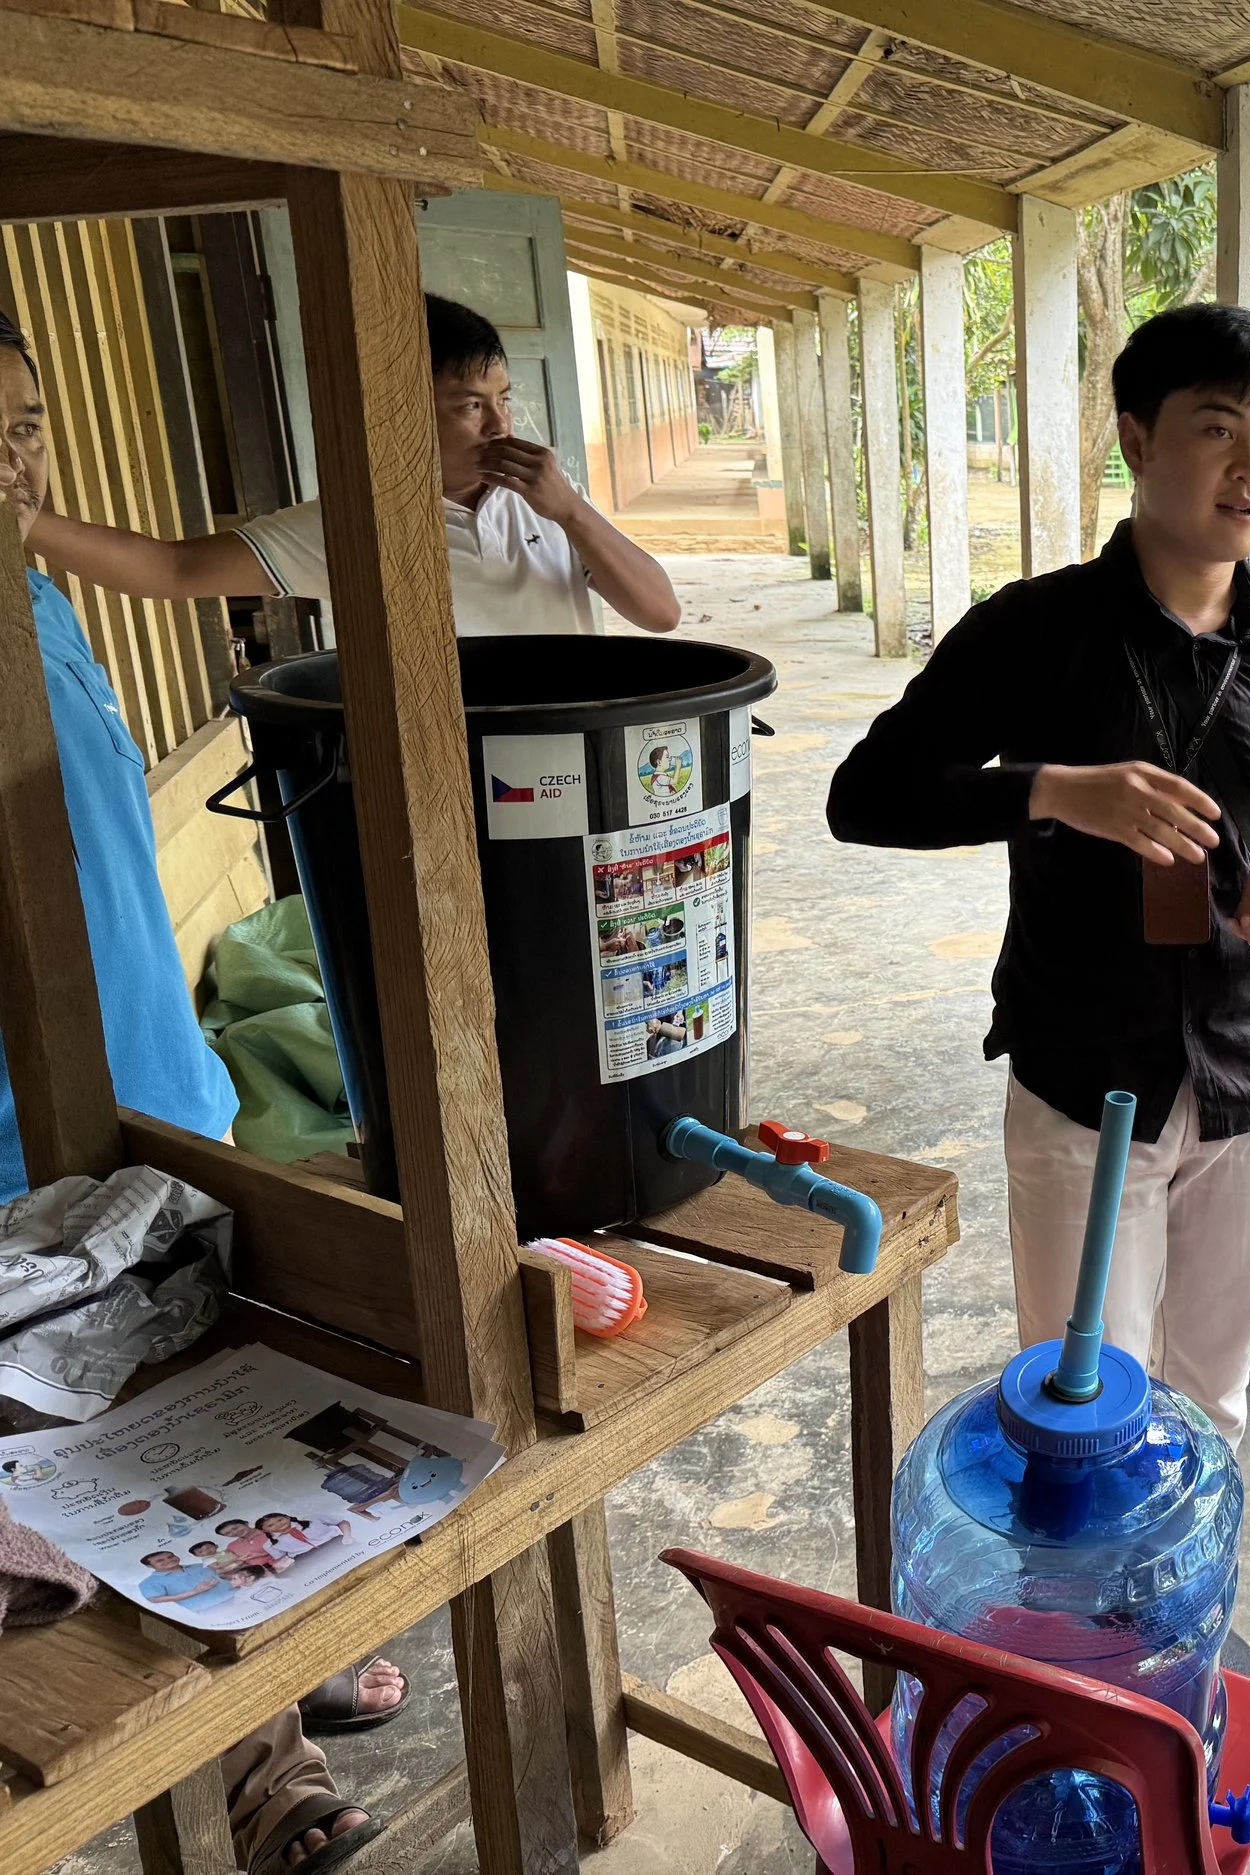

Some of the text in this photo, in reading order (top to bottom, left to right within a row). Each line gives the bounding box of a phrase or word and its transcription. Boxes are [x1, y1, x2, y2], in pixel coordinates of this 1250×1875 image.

[1200, 714, 1211, 728] Your
[1208, 696, 1220, 716] partner
[539, 774, 582, 786] CZECH
[539, 788, 562, 800] AID
[649, 811, 661, 820] 030
[662, 809, 673, 818] 517
